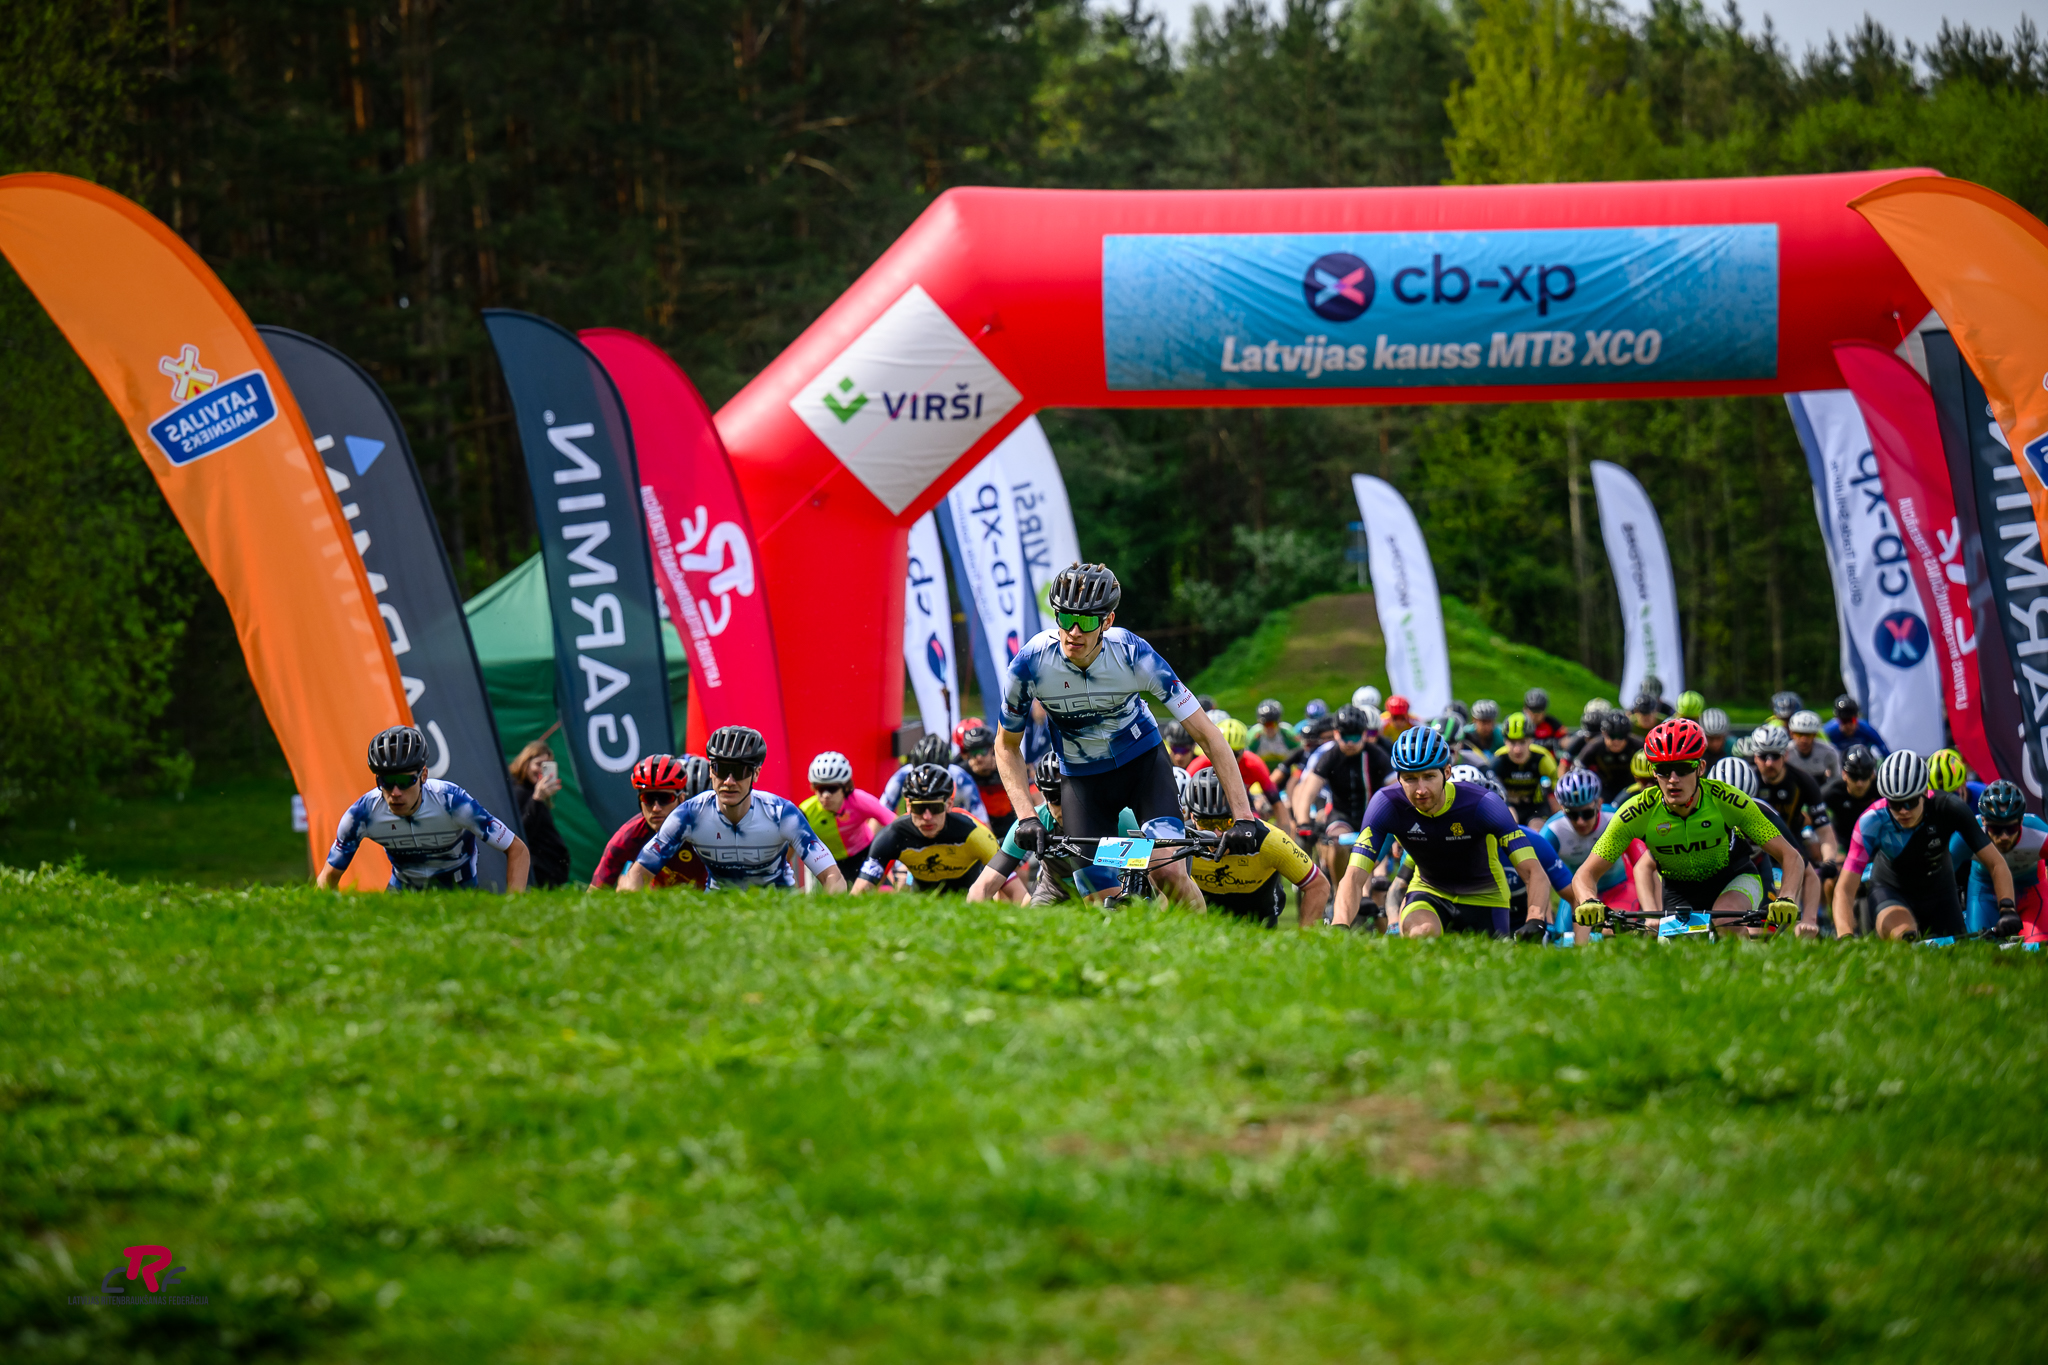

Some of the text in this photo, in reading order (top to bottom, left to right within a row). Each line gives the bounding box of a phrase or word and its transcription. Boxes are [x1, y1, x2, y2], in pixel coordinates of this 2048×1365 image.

[1391, 254, 1577, 315] cb-xp
[1221, 328, 1663, 378] Latvijas kauss MTB XCO
[881, 382, 984, 421] VIRŠI
[1619, 795, 1657, 823] EMU
[1710, 784, 1749, 809] EMU
[1119, 841, 1135, 858] 7
[1655, 838, 1722, 855] EMU
